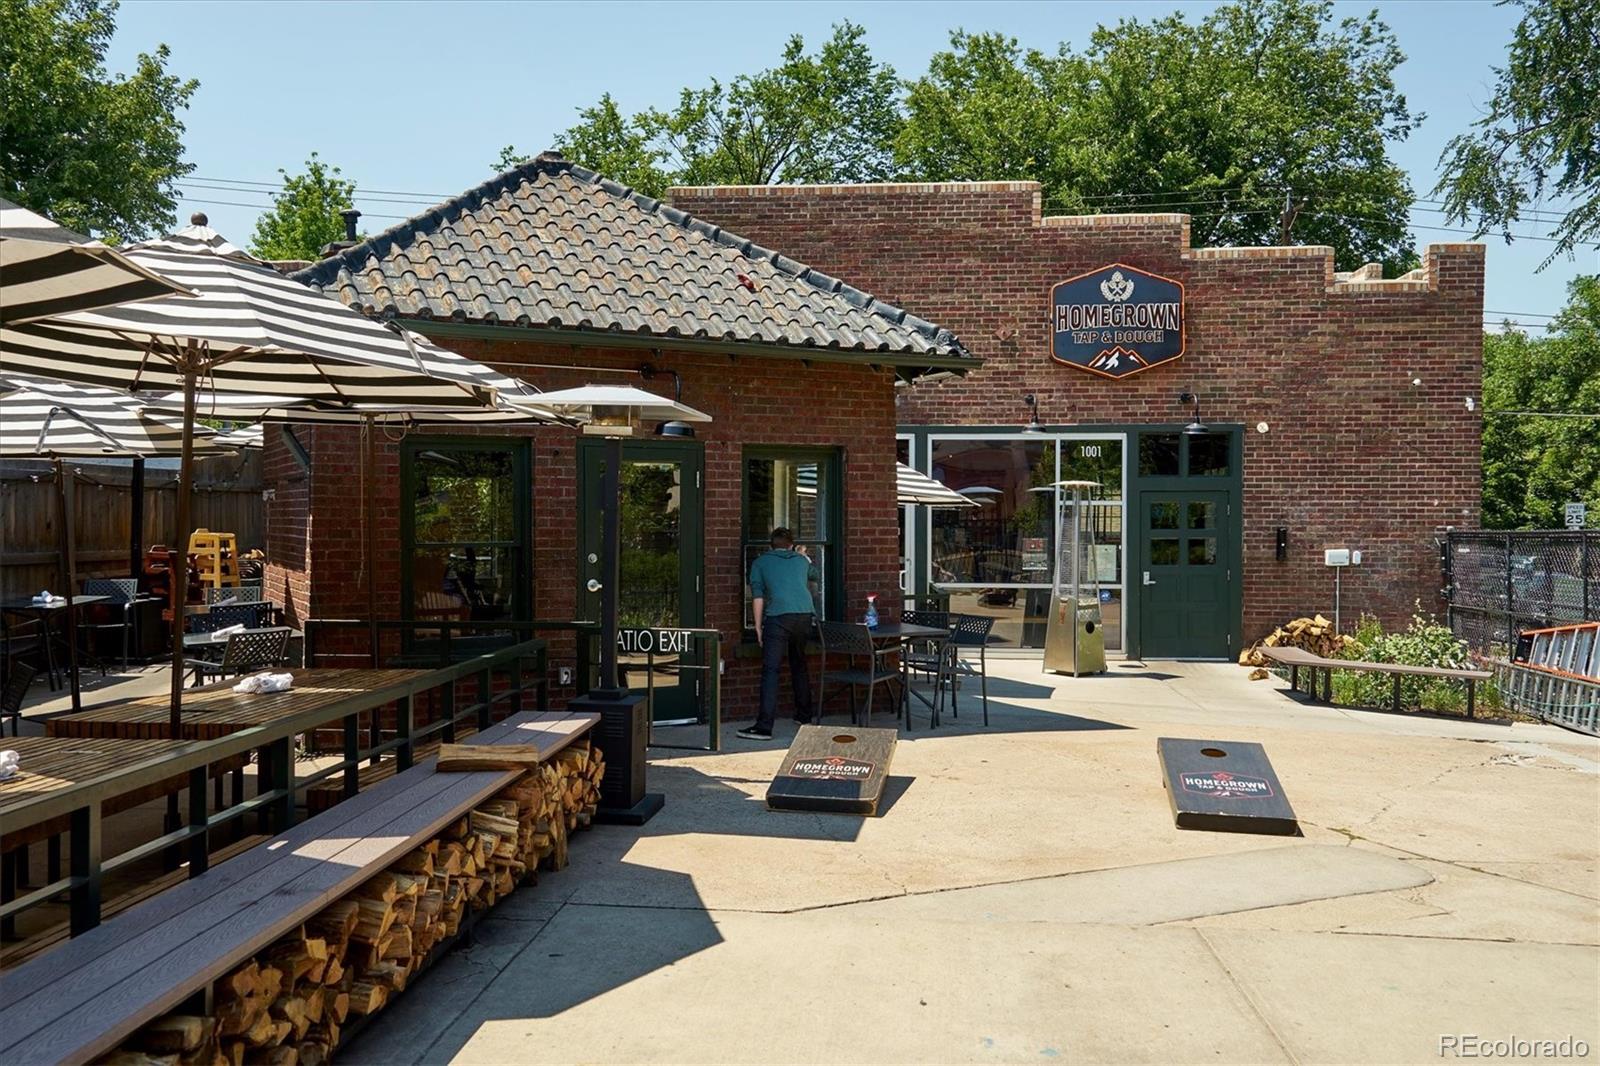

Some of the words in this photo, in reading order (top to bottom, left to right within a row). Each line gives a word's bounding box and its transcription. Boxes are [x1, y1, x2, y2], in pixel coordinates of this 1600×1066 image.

[1056, 303, 1180, 333] HOMEGROWN
[1072, 330, 1099, 344] TAP
[1101, 331, 1113, 344] &
[1114, 330, 1164, 343] DOUGH
[1081, 445, 1101, 457] 1001
[1566, 515, 1583, 524] 25
[616, 630, 654, 652] ATIO
[659, 631, 692, 652] EXIT
[795, 763, 870, 774] HOMEGROWN
[1185, 778, 1267, 790] HOMEGROWN
